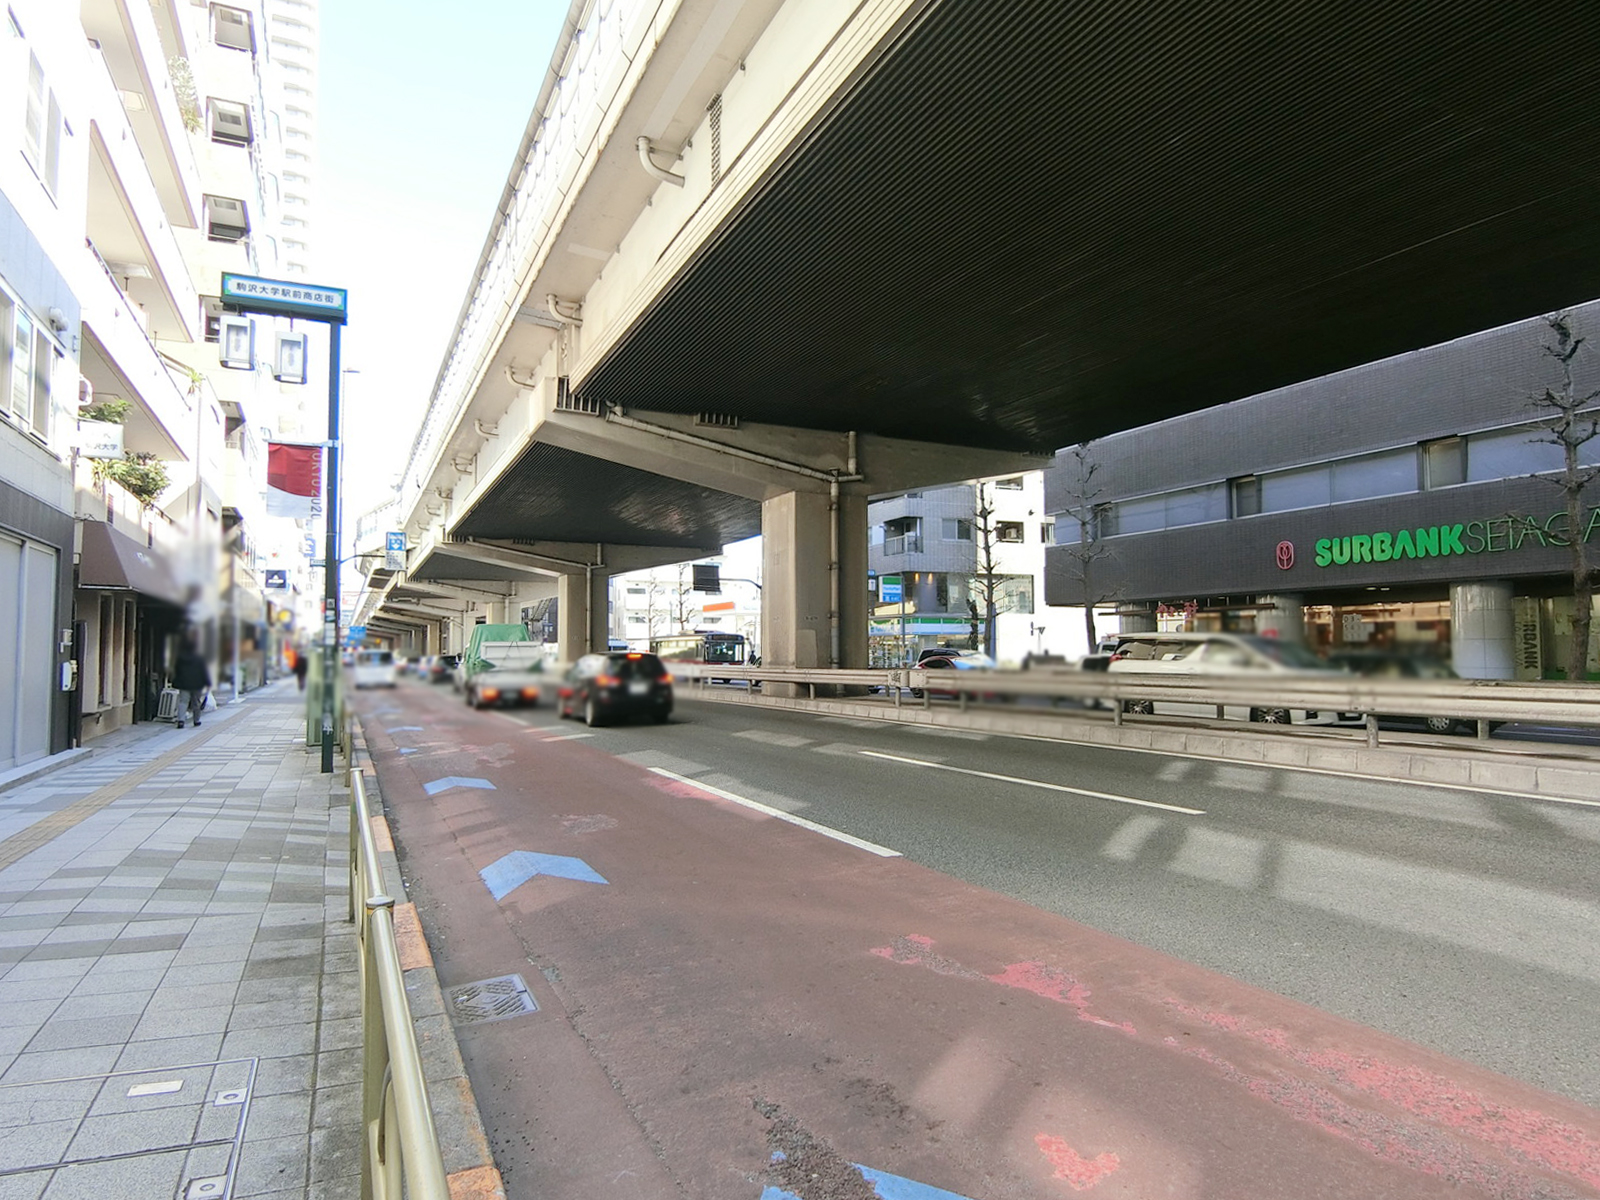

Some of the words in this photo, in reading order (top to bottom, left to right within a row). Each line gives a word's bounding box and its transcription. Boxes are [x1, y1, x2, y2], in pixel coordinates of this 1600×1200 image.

[236, 281, 334, 304] 駒沢大学駅前商店街
[1314, 523, 1465, 567] SURBANK
